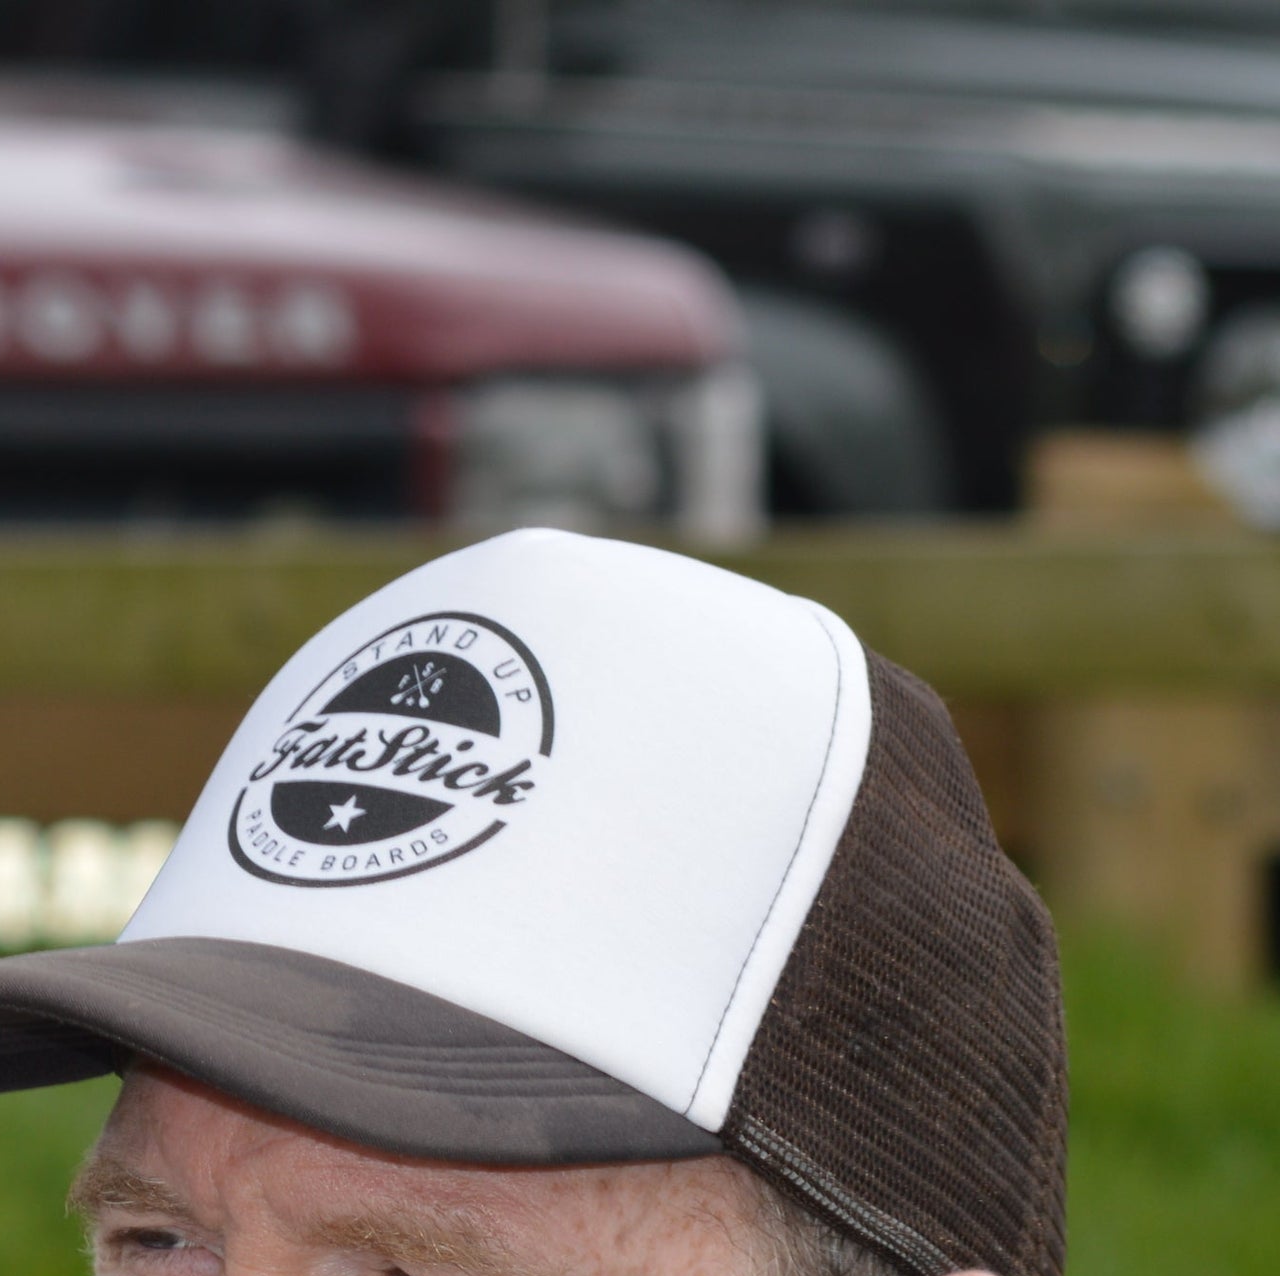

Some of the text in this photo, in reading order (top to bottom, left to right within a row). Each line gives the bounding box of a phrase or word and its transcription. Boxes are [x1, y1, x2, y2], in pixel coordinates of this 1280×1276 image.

[343, 625, 533, 704] STAND UP
[249, 718, 536, 805] FatStick
[246, 808, 449, 872] PADDLE BOARDS
